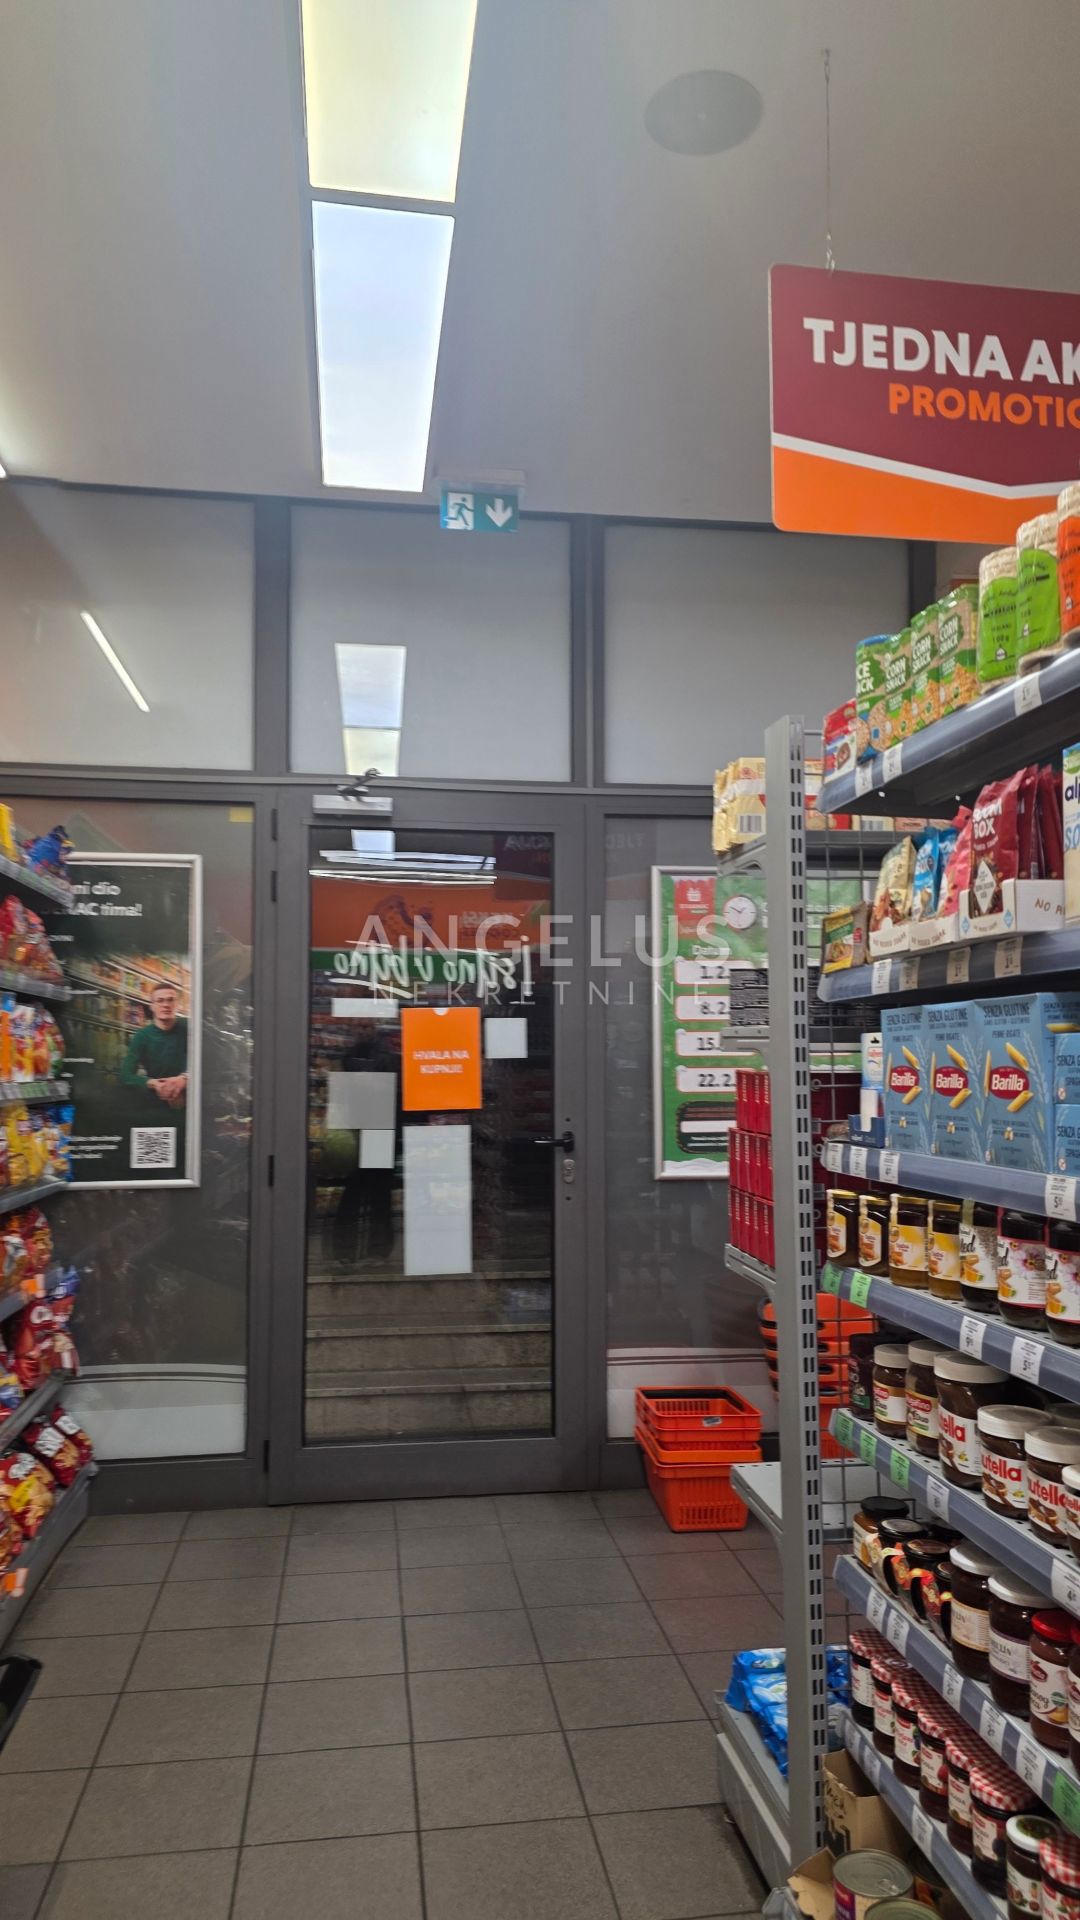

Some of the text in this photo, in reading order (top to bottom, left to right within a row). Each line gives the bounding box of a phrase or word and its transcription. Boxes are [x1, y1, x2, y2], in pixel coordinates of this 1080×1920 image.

[803, 317, 1013, 381] TJEDNA
[939, 615, 958, 642] CORN
[912, 634, 931, 662] CORN
[891, 1072, 916, 1086] Barilla
[935, 1073, 964, 1088] Barilla
[991, 1074, 1024, 1091] Barilla
